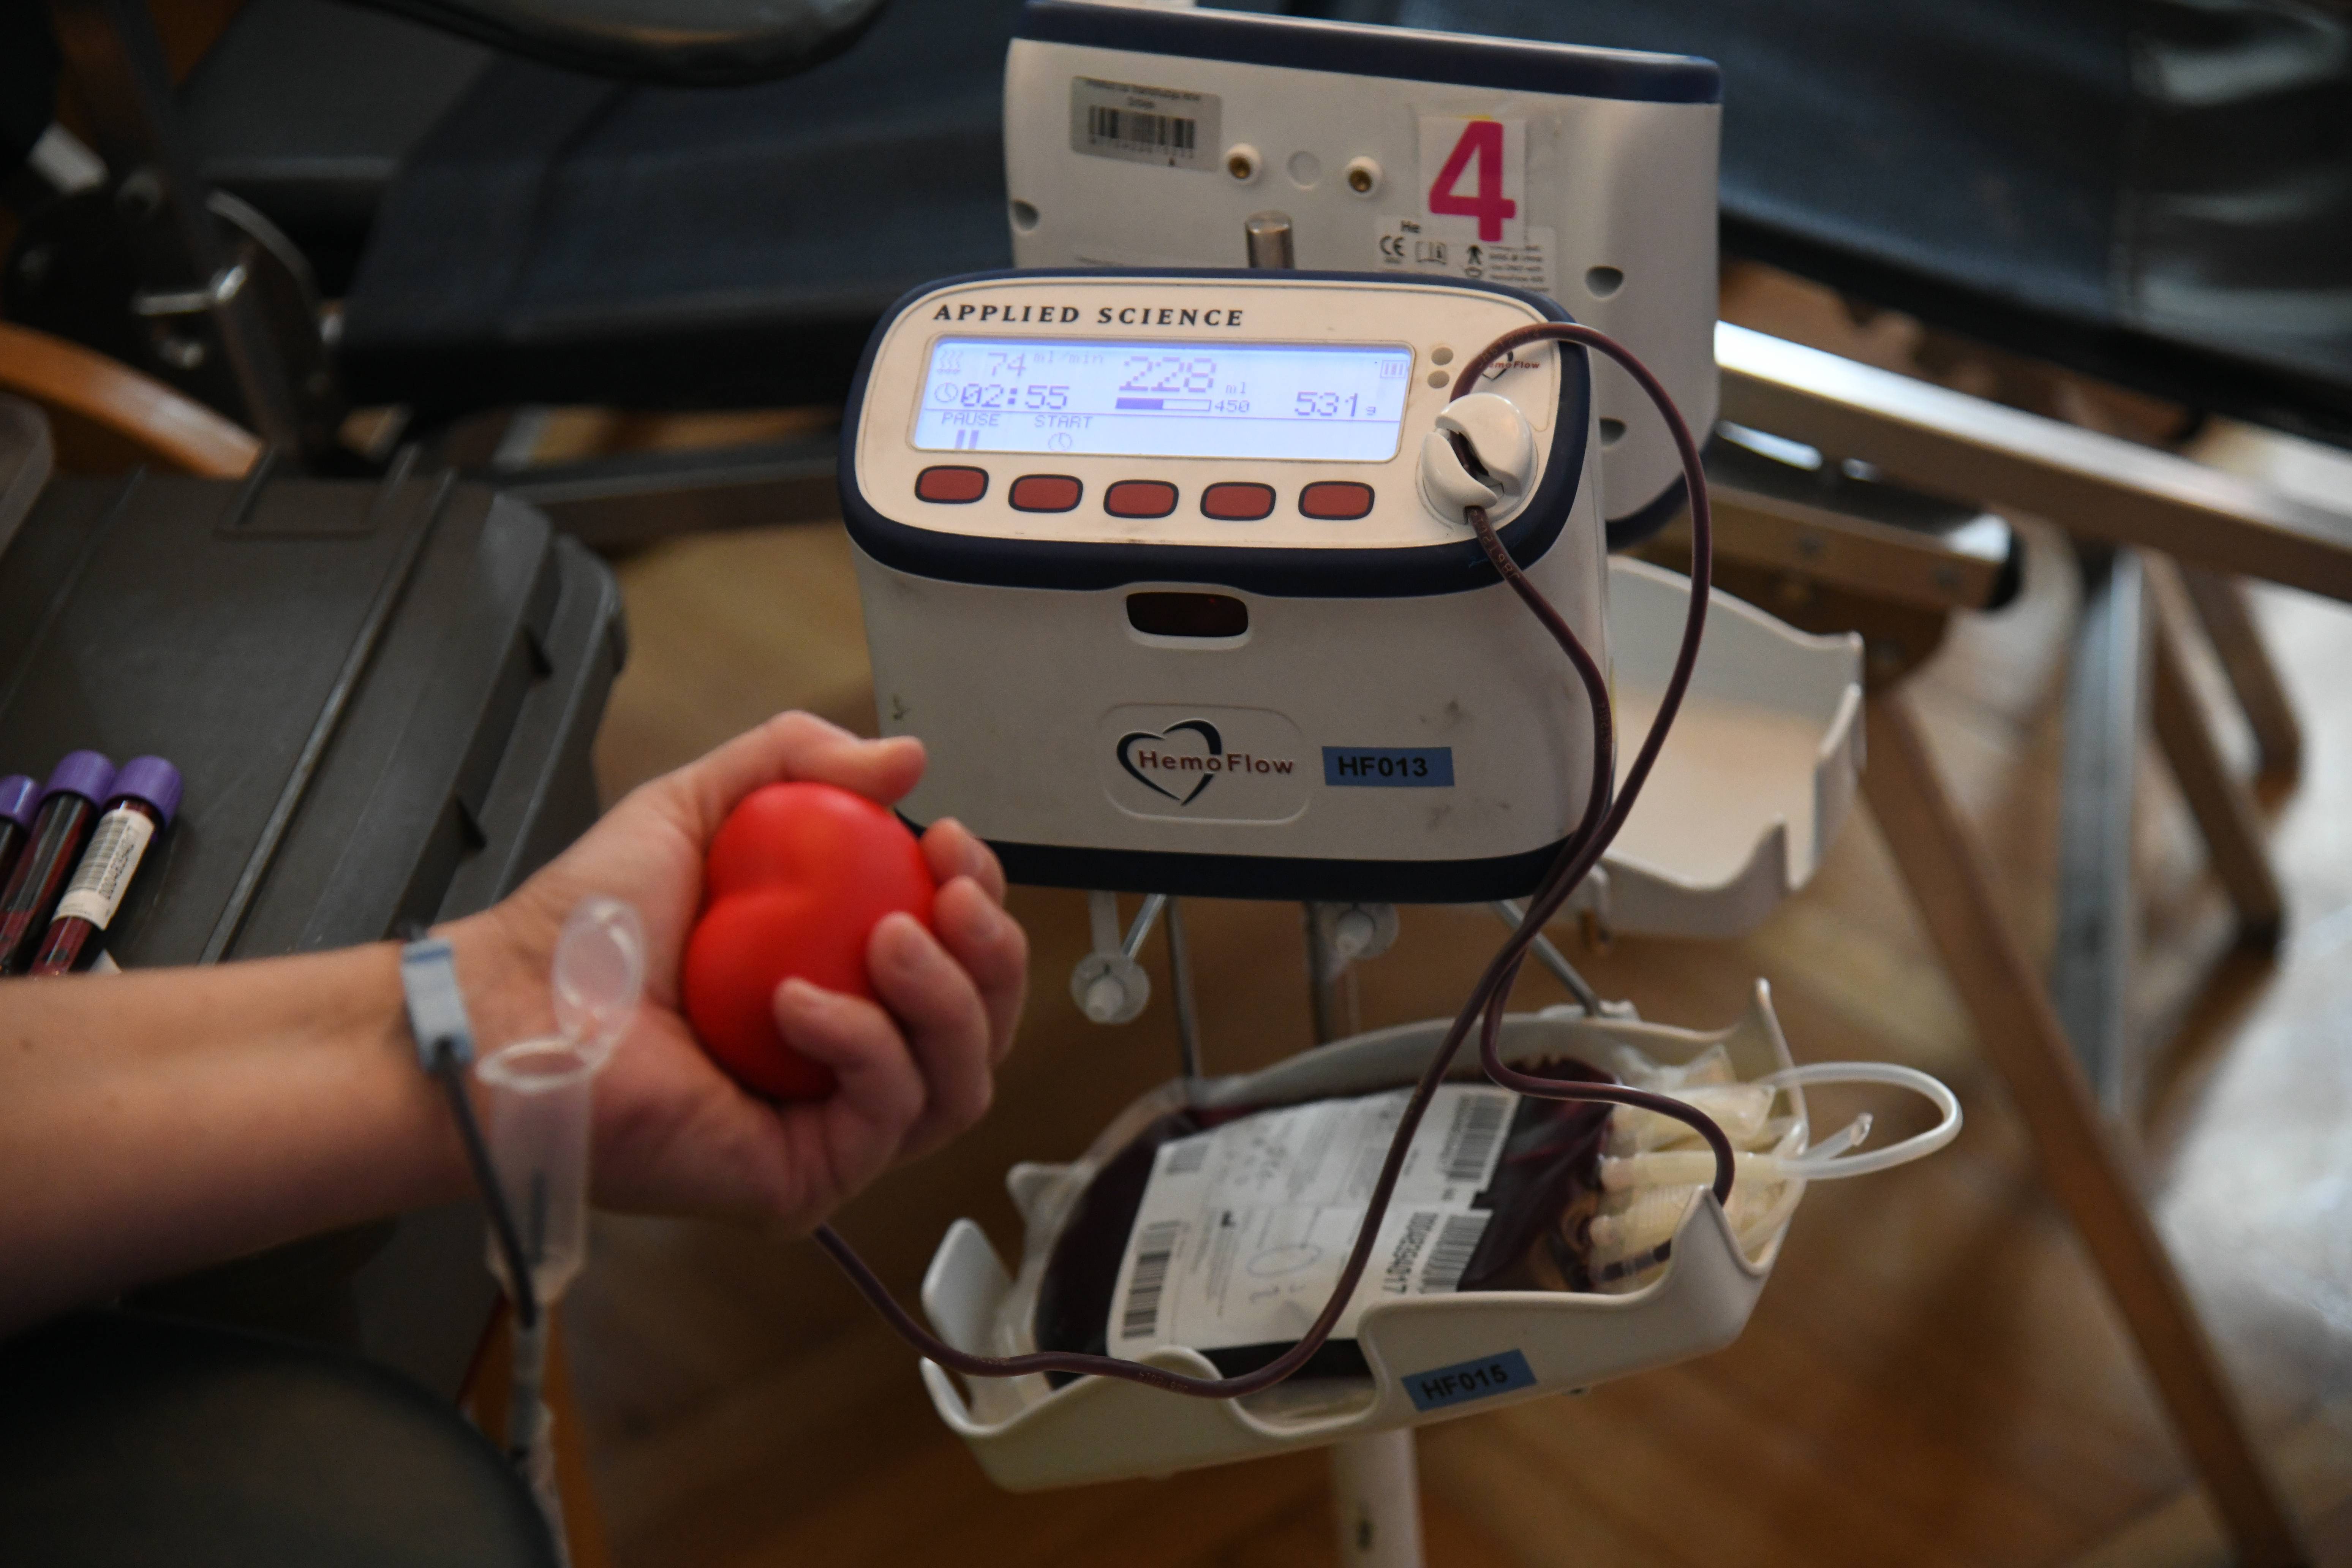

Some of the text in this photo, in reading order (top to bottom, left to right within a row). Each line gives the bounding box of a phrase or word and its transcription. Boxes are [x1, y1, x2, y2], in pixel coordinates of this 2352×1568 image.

[1429, 120, 1517, 242] 4
[933, 304, 1244, 327] APPLIED SCIENCE
[988, 352, 1027, 377] 74
[1119, 356, 1246, 394] 228 ml
[960, 383, 1069, 409] 02:55
[1214, 400, 1250, 412] 450
[1295, 391, 1359, 417] 531
[942, 412, 1093, 429] PAUSE START
[1139, 749, 1294, 775] HemoFlow
[1338, 756, 1429, 777] HF013
[1421, 1364, 1508, 1400] HF015
